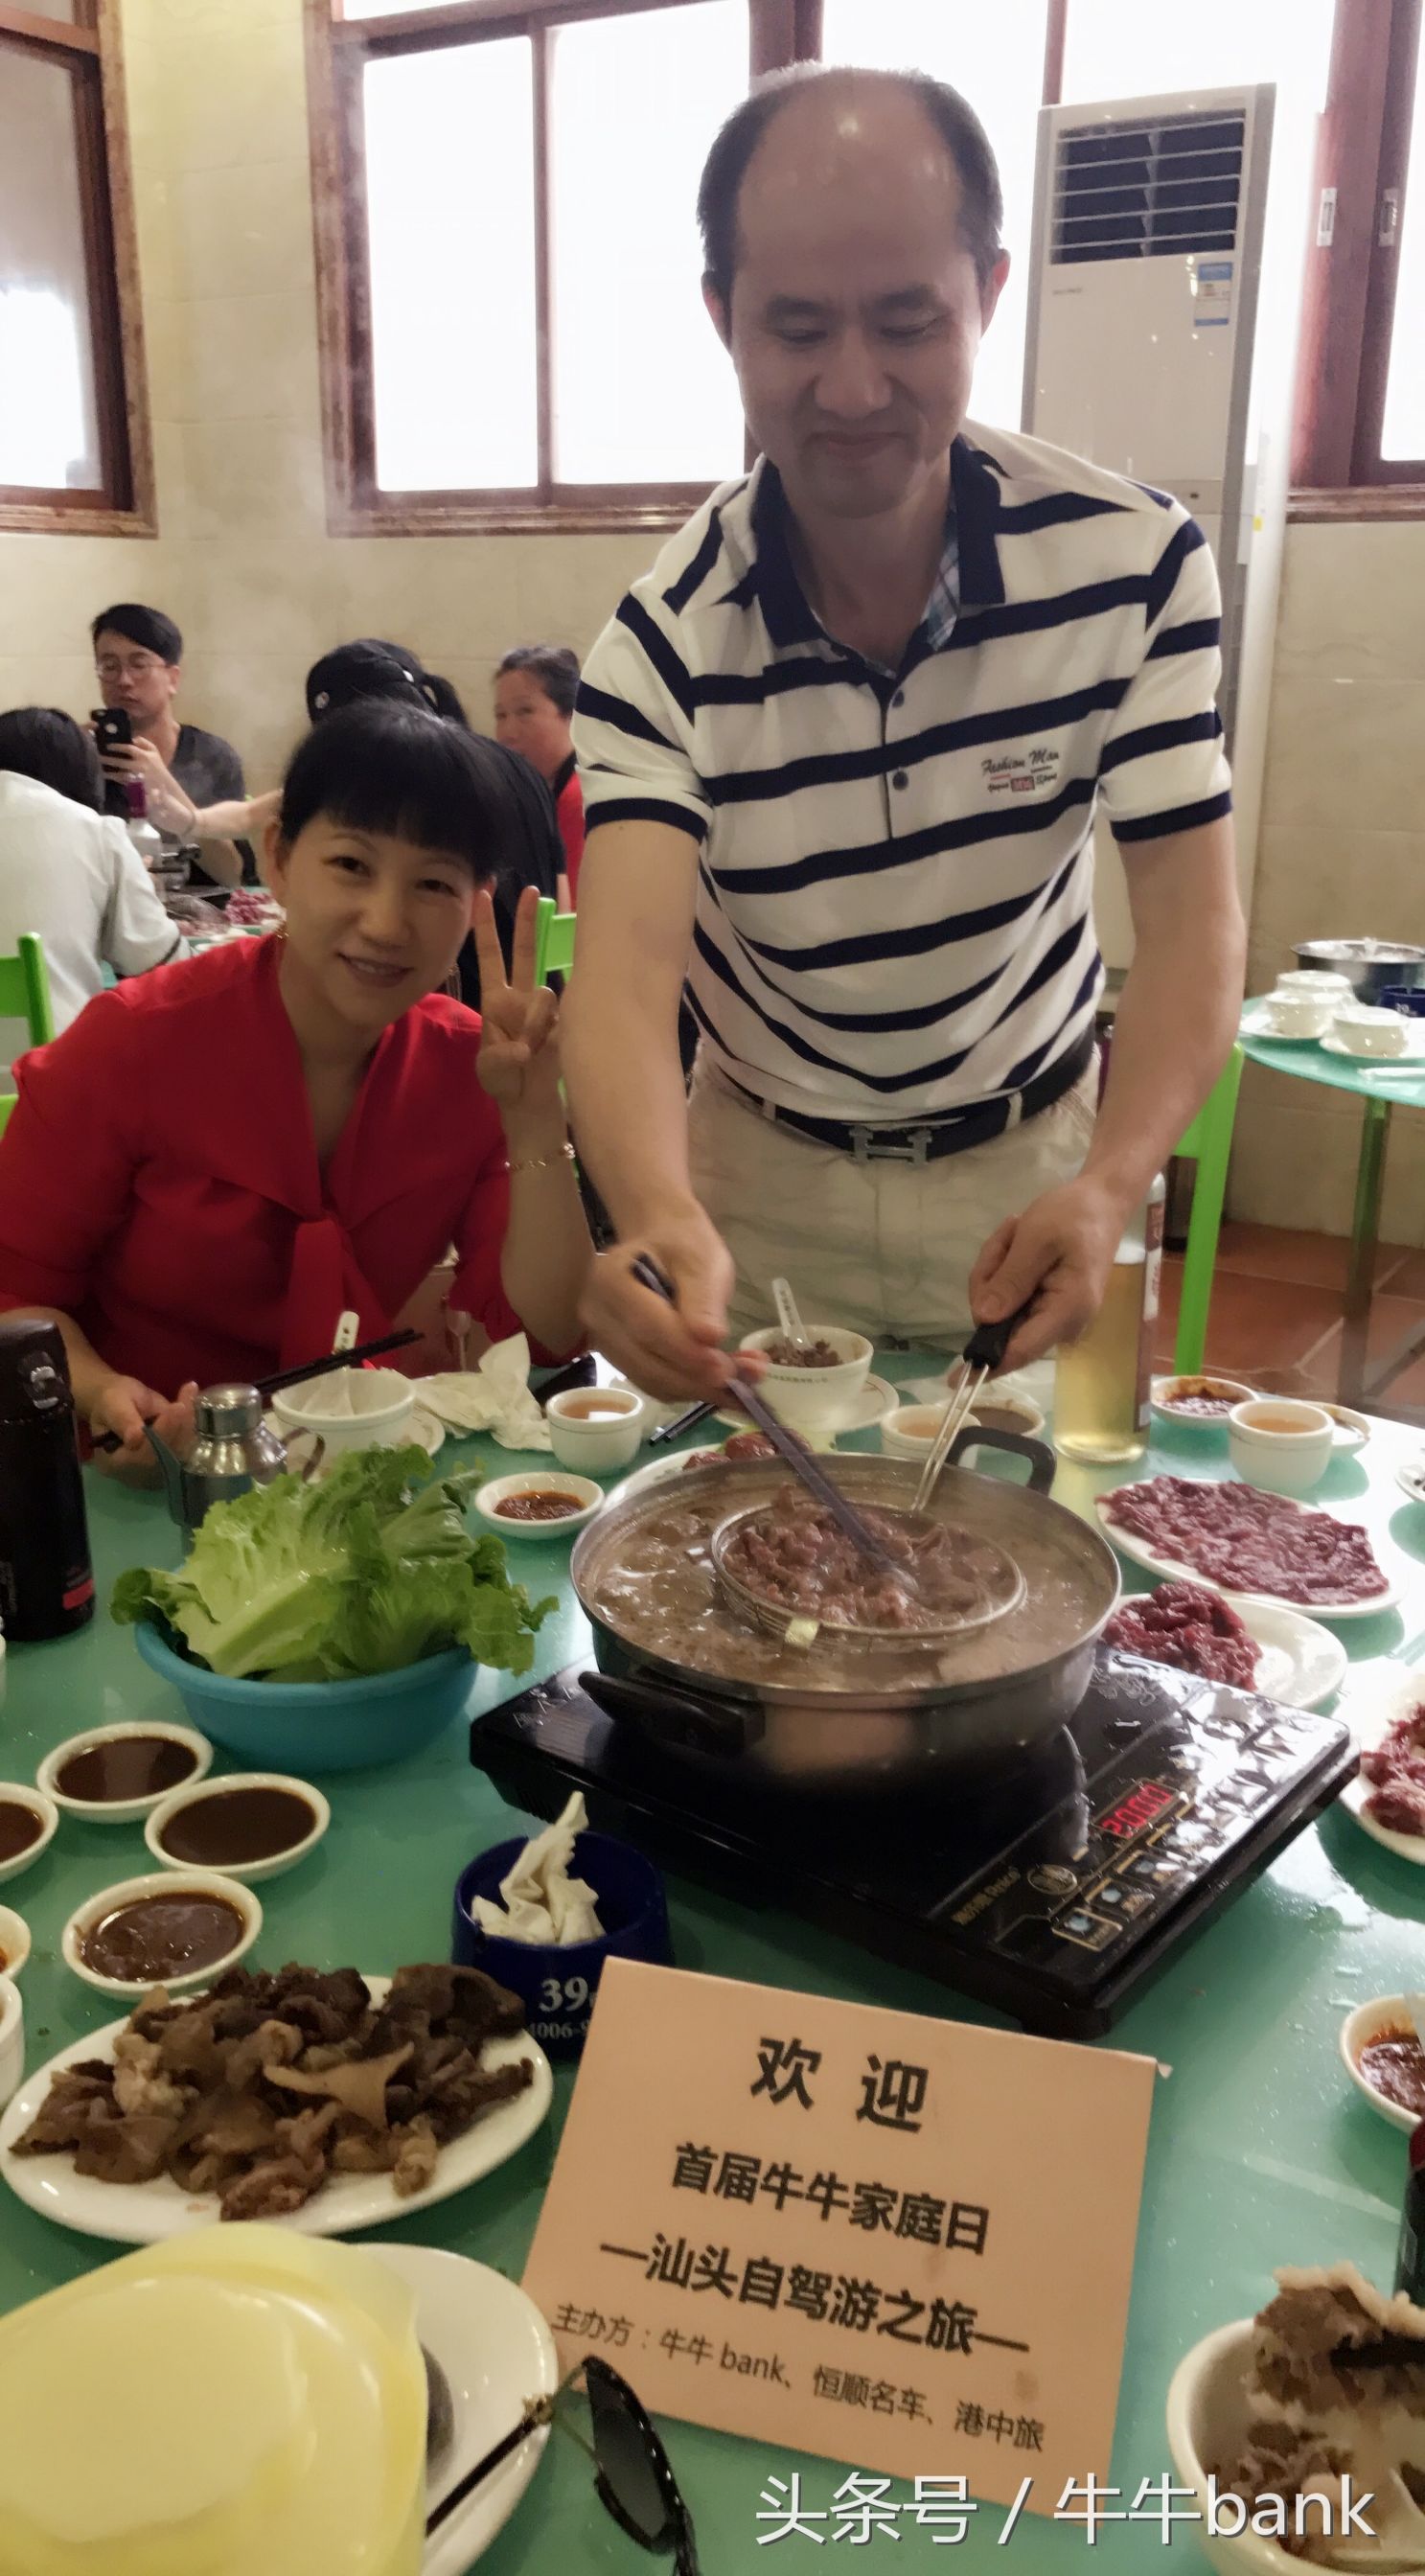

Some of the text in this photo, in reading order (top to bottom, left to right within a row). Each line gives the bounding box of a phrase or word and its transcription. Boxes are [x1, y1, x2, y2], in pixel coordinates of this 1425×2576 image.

[750, 2036, 930, 2133] 欢 迎
[671, 2143, 990, 2256] 首届牛牛家庭日
